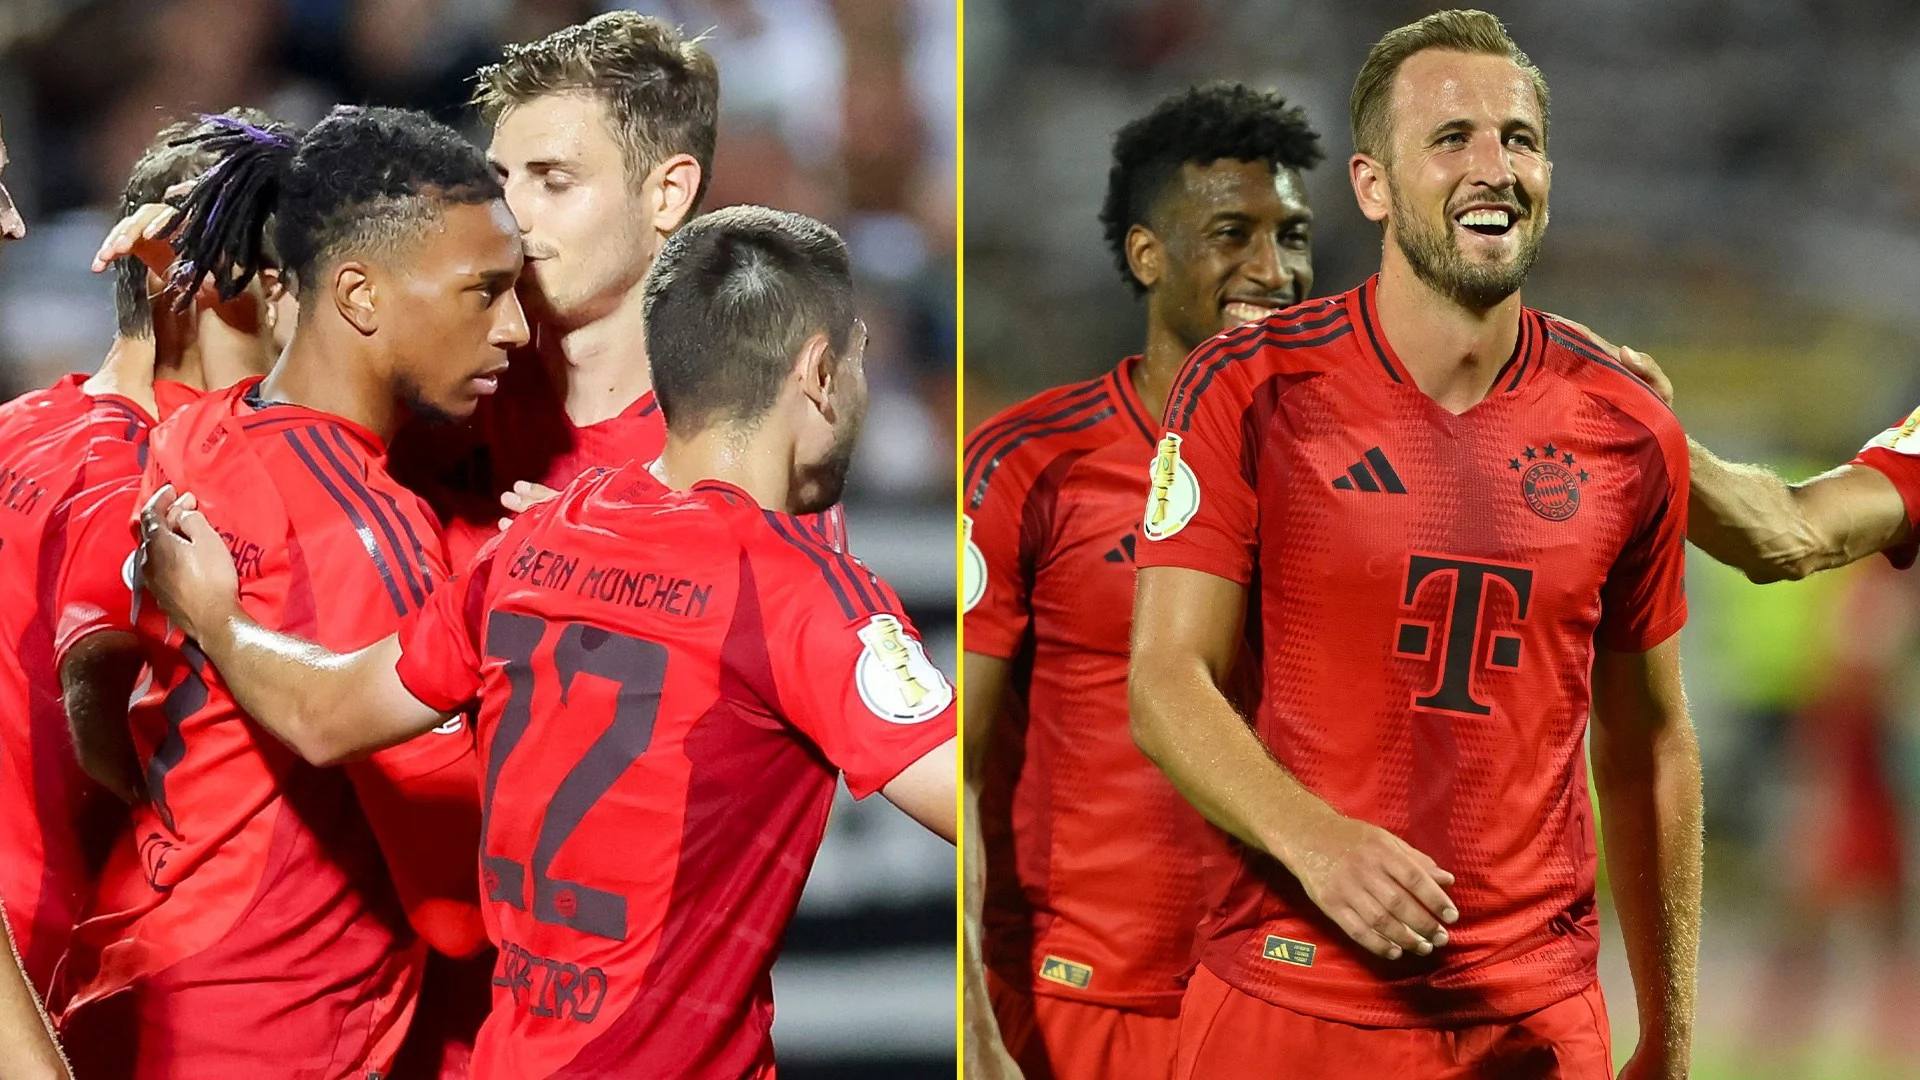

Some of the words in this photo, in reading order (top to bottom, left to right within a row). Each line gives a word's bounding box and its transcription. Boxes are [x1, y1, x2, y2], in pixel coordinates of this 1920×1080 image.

[578, 566, 713, 617] MÜNCHEN
[1396, 552, 1536, 718] T
[481, 608, 669, 942] 22
